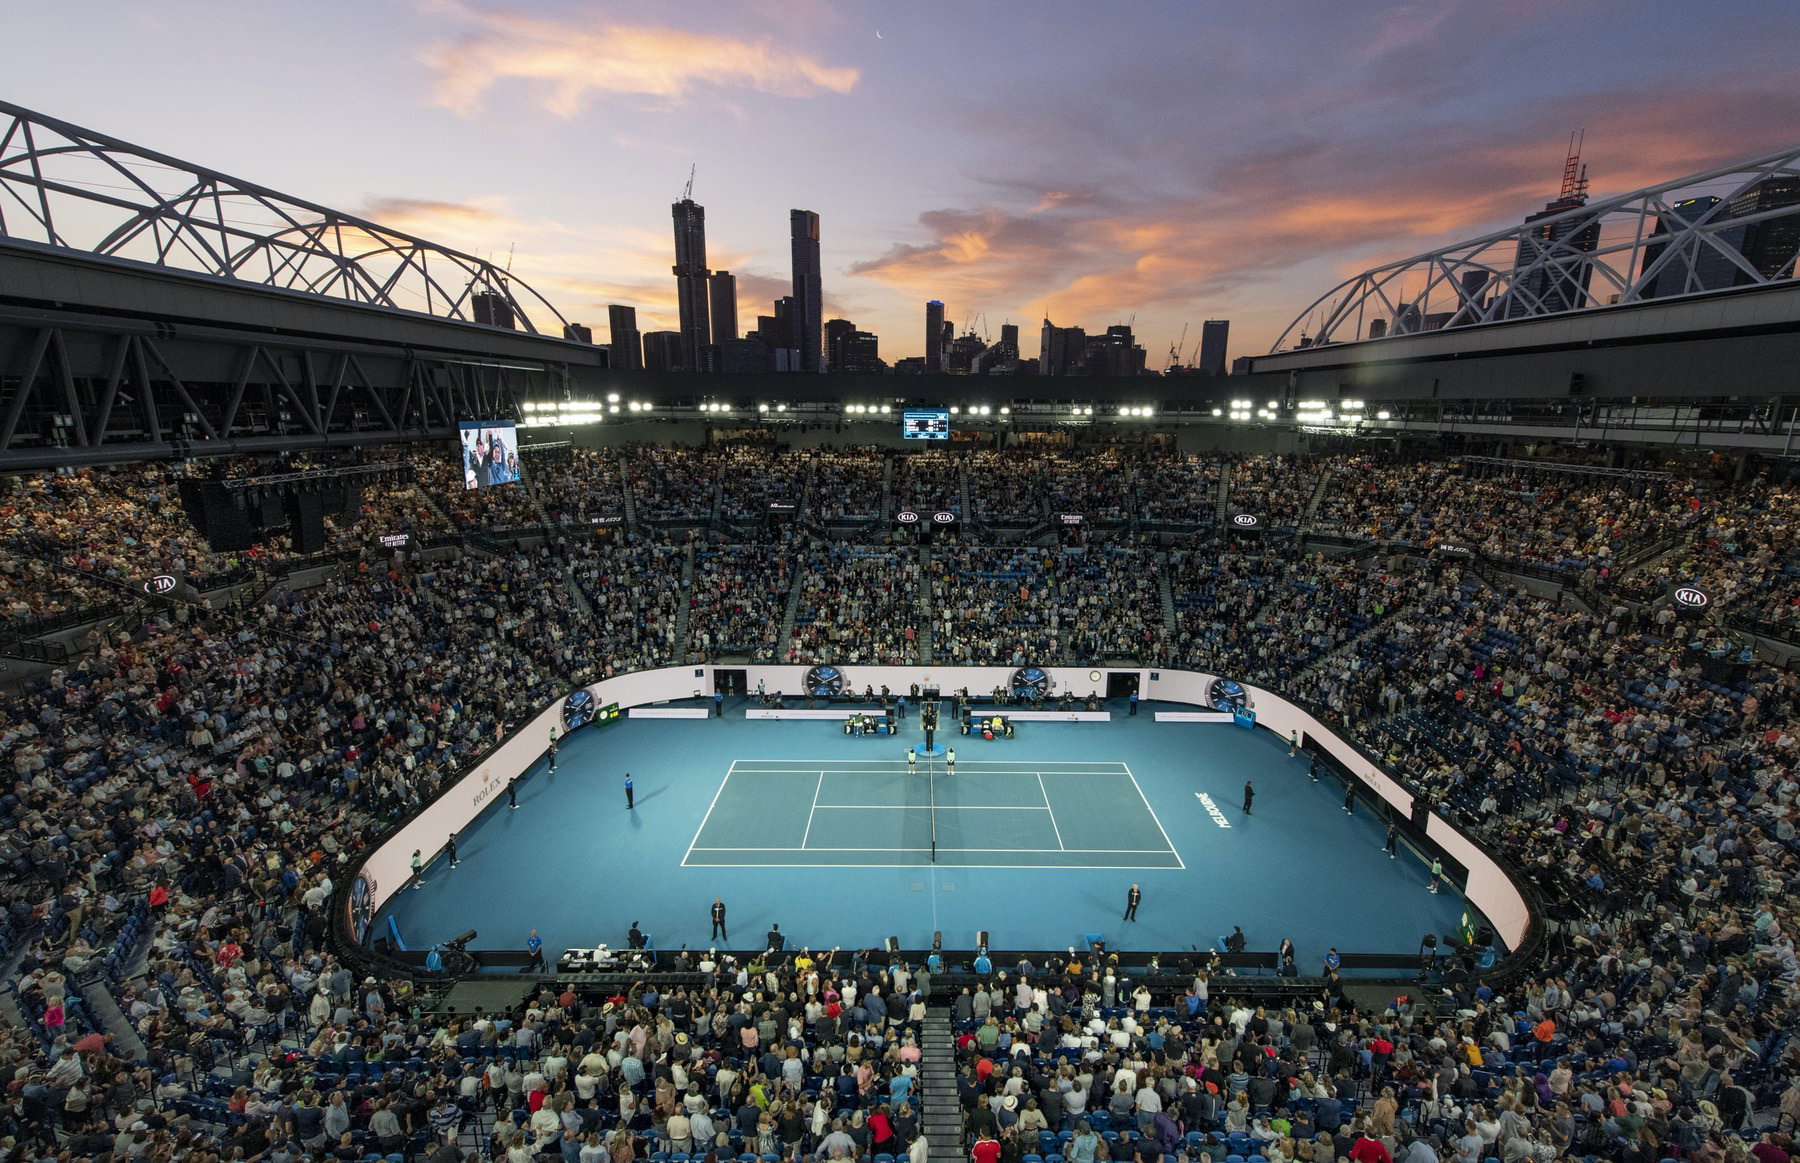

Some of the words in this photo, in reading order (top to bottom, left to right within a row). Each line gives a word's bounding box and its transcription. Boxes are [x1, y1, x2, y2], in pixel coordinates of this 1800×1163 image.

[380, 534, 409, 543] Emirates
[1680, 590, 1701, 604] KIA
[473, 776, 501, 807] ROLEX
[1194, 792, 1232, 828] MELBOURNE
